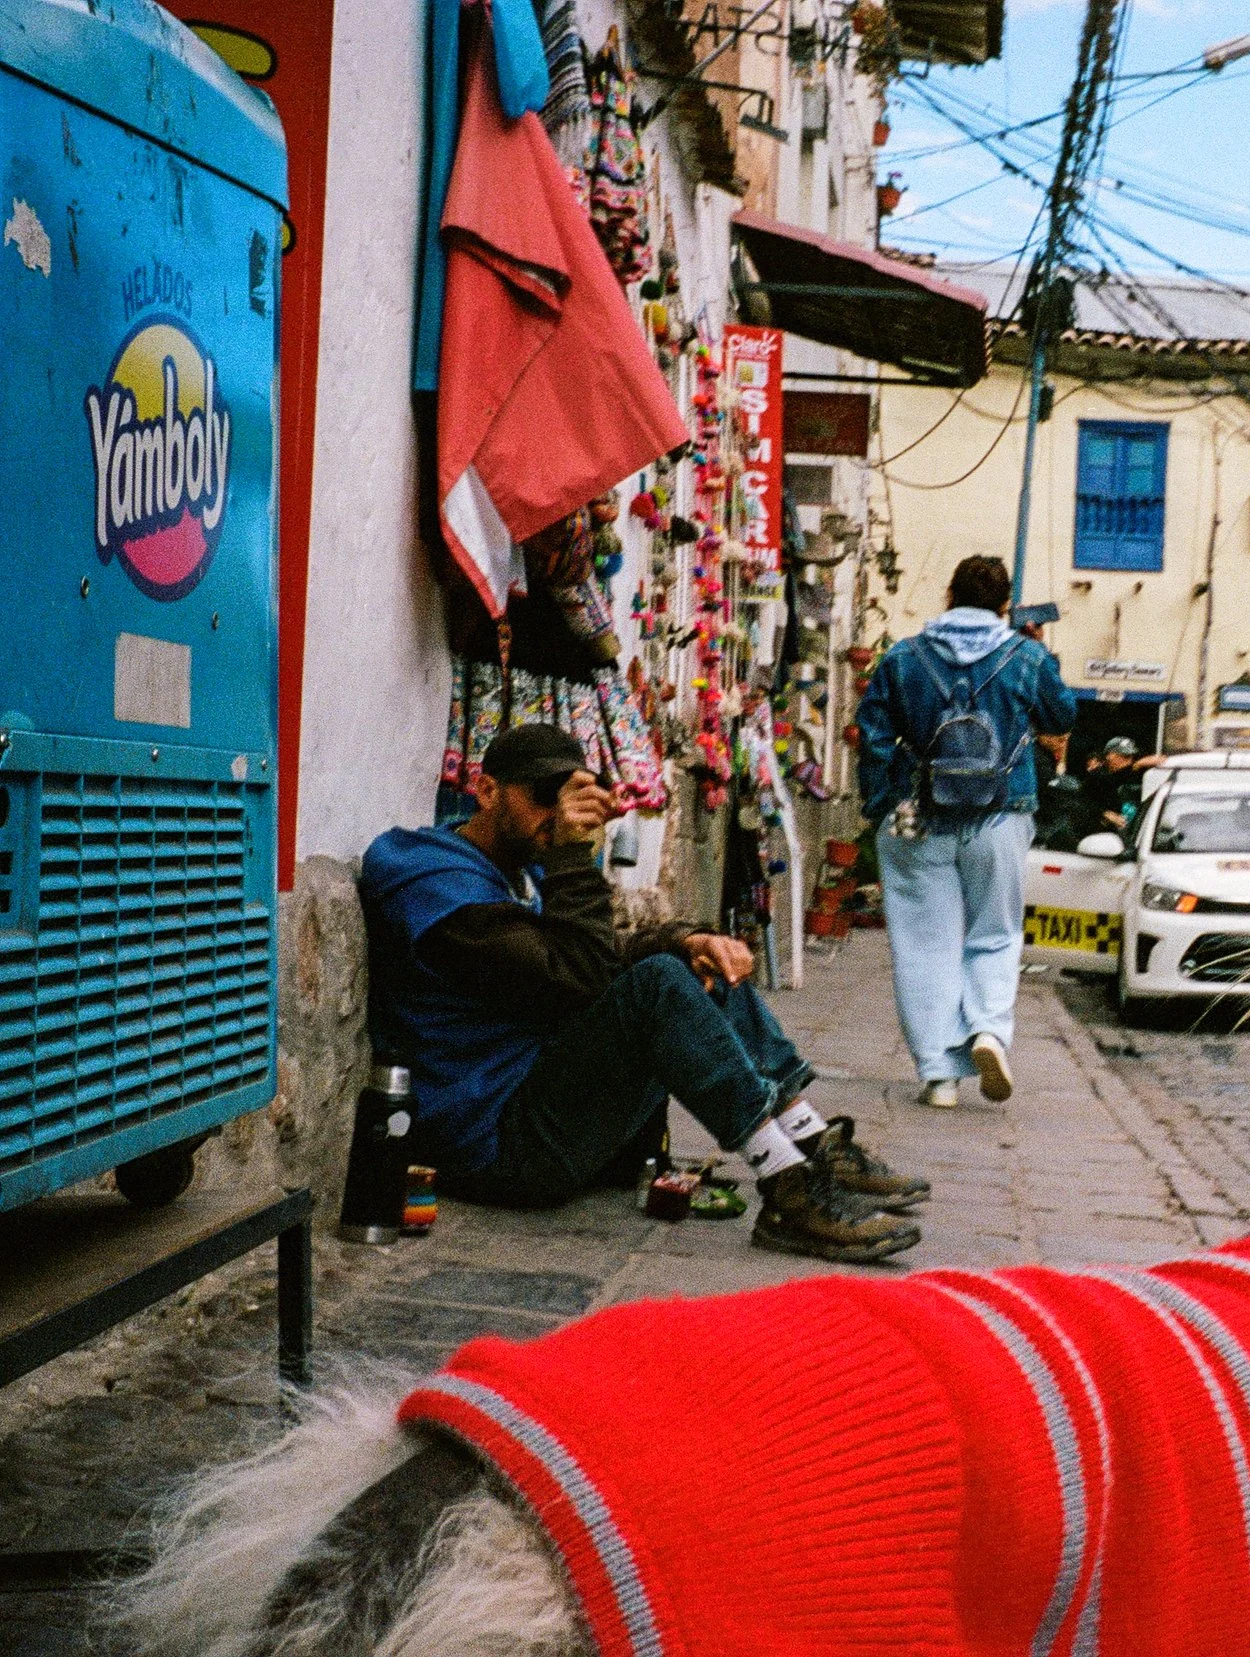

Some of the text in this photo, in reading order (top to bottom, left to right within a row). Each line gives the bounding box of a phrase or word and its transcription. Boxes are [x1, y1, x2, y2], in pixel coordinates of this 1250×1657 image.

[121, 262, 193, 323] HELADOS
[88, 358, 230, 546] Yámboly
[1038, 913, 1081, 945] TAXI
